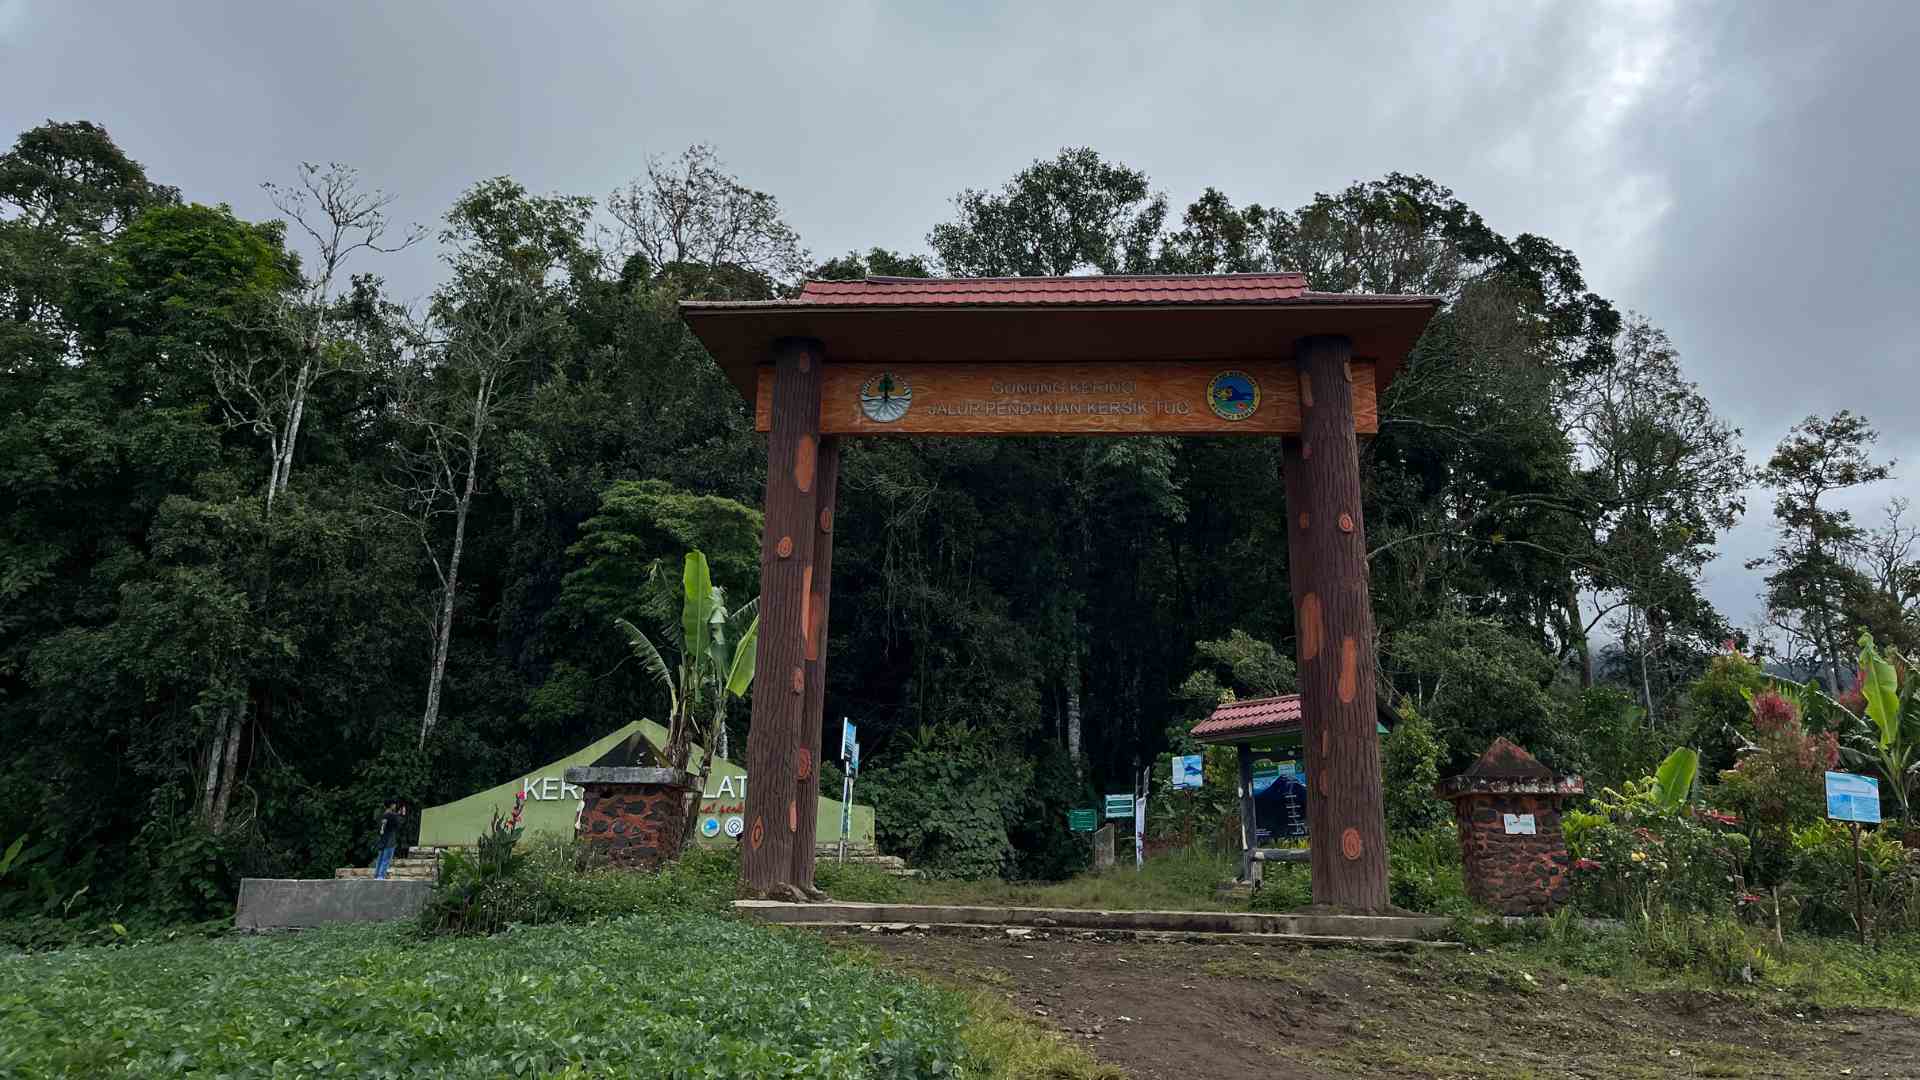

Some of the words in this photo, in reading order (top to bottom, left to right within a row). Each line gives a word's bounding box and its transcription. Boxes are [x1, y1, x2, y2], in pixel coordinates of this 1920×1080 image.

[991, 382, 1065, 395] GUNUNG
[1070, 382, 1137, 395] KERINCI
[927, 401, 980, 417] JALUR
[984, 401, 1082, 417] PENDAKIAN
[1086, 400, 1148, 417] KERSIK
[1152, 400, 1193, 417] TUO
[523, 777, 581, 801] KER
[702, 775, 748, 799] LAT
